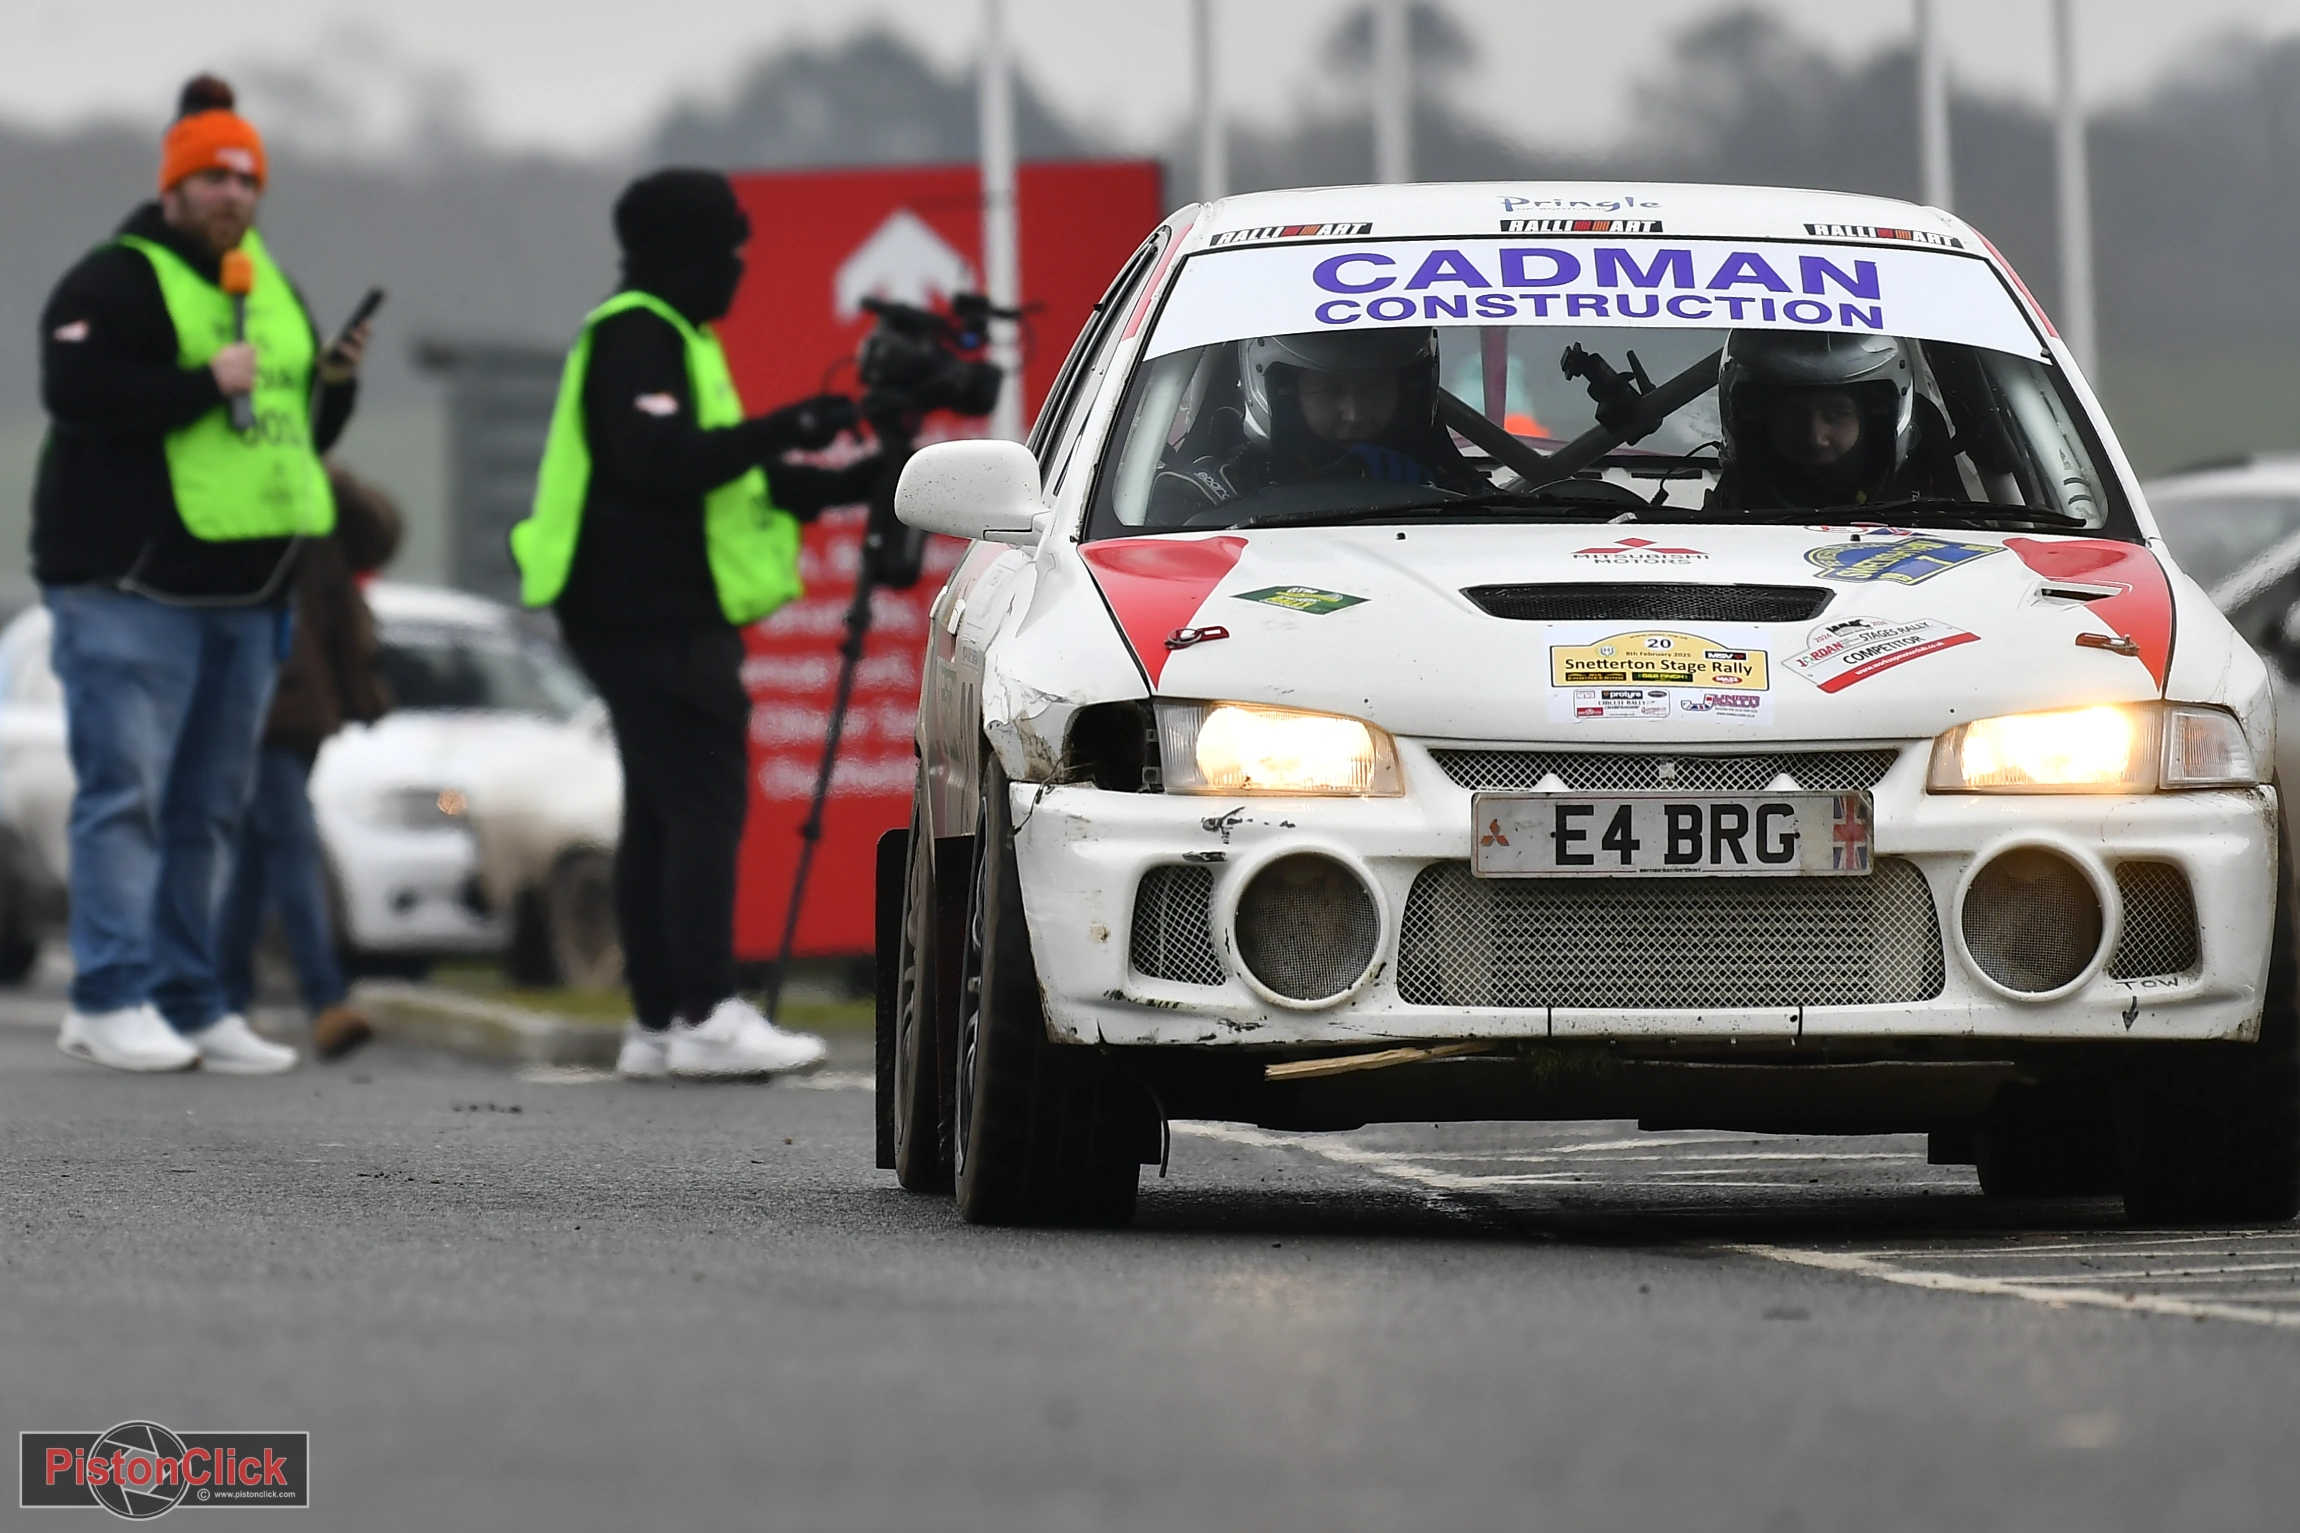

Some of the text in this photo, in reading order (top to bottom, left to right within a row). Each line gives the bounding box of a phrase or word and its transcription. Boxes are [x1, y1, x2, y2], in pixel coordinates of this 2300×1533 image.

[1497, 196, 1662, 212] Pringle
[1218, 222, 1368, 245] RALLI ART
[1508, 220, 1657, 233] RALLI ART
[1813, 224, 1955, 247] RALLI ART
[1312, 246, 1879, 300] CADMAN
[1313, 292, 1885, 330] CONSTRUCTION
[1193, 471, 1231, 501] sparc
[1813, 633, 1833, 644] 2024
[1859, 629, 1899, 642] STAGES
[1899, 621, 1930, 635] RALLY
[1646, 638, 1672, 649] 20
[1842, 635, 1926, 665] COMPETITOR
[1639, 651, 1673, 659] February
[1564, 658, 1753, 676] Snetterton Stage Rally
[1610, 690, 1642, 699] protyre
[1555, 803, 1796, 865] E4 BRG
[2115, 977, 2179, 990] TOW
